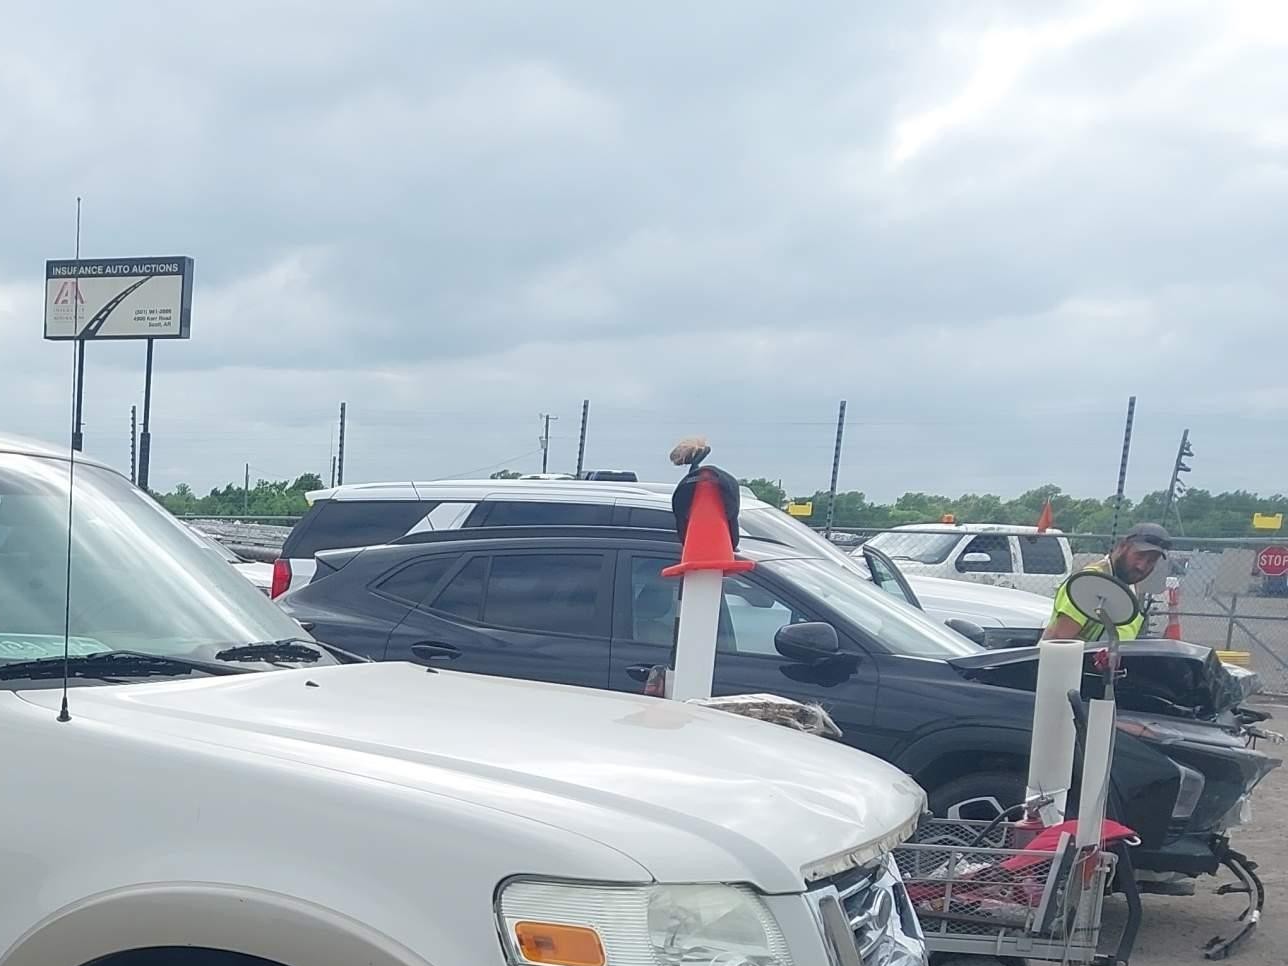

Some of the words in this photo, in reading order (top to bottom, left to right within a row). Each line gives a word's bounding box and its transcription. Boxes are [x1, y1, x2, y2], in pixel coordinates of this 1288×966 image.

[105, 264, 130, 274] AUTO
[132, 263, 179, 273] AUCTIONS
[1260, 554, 1288, 567] STOP
